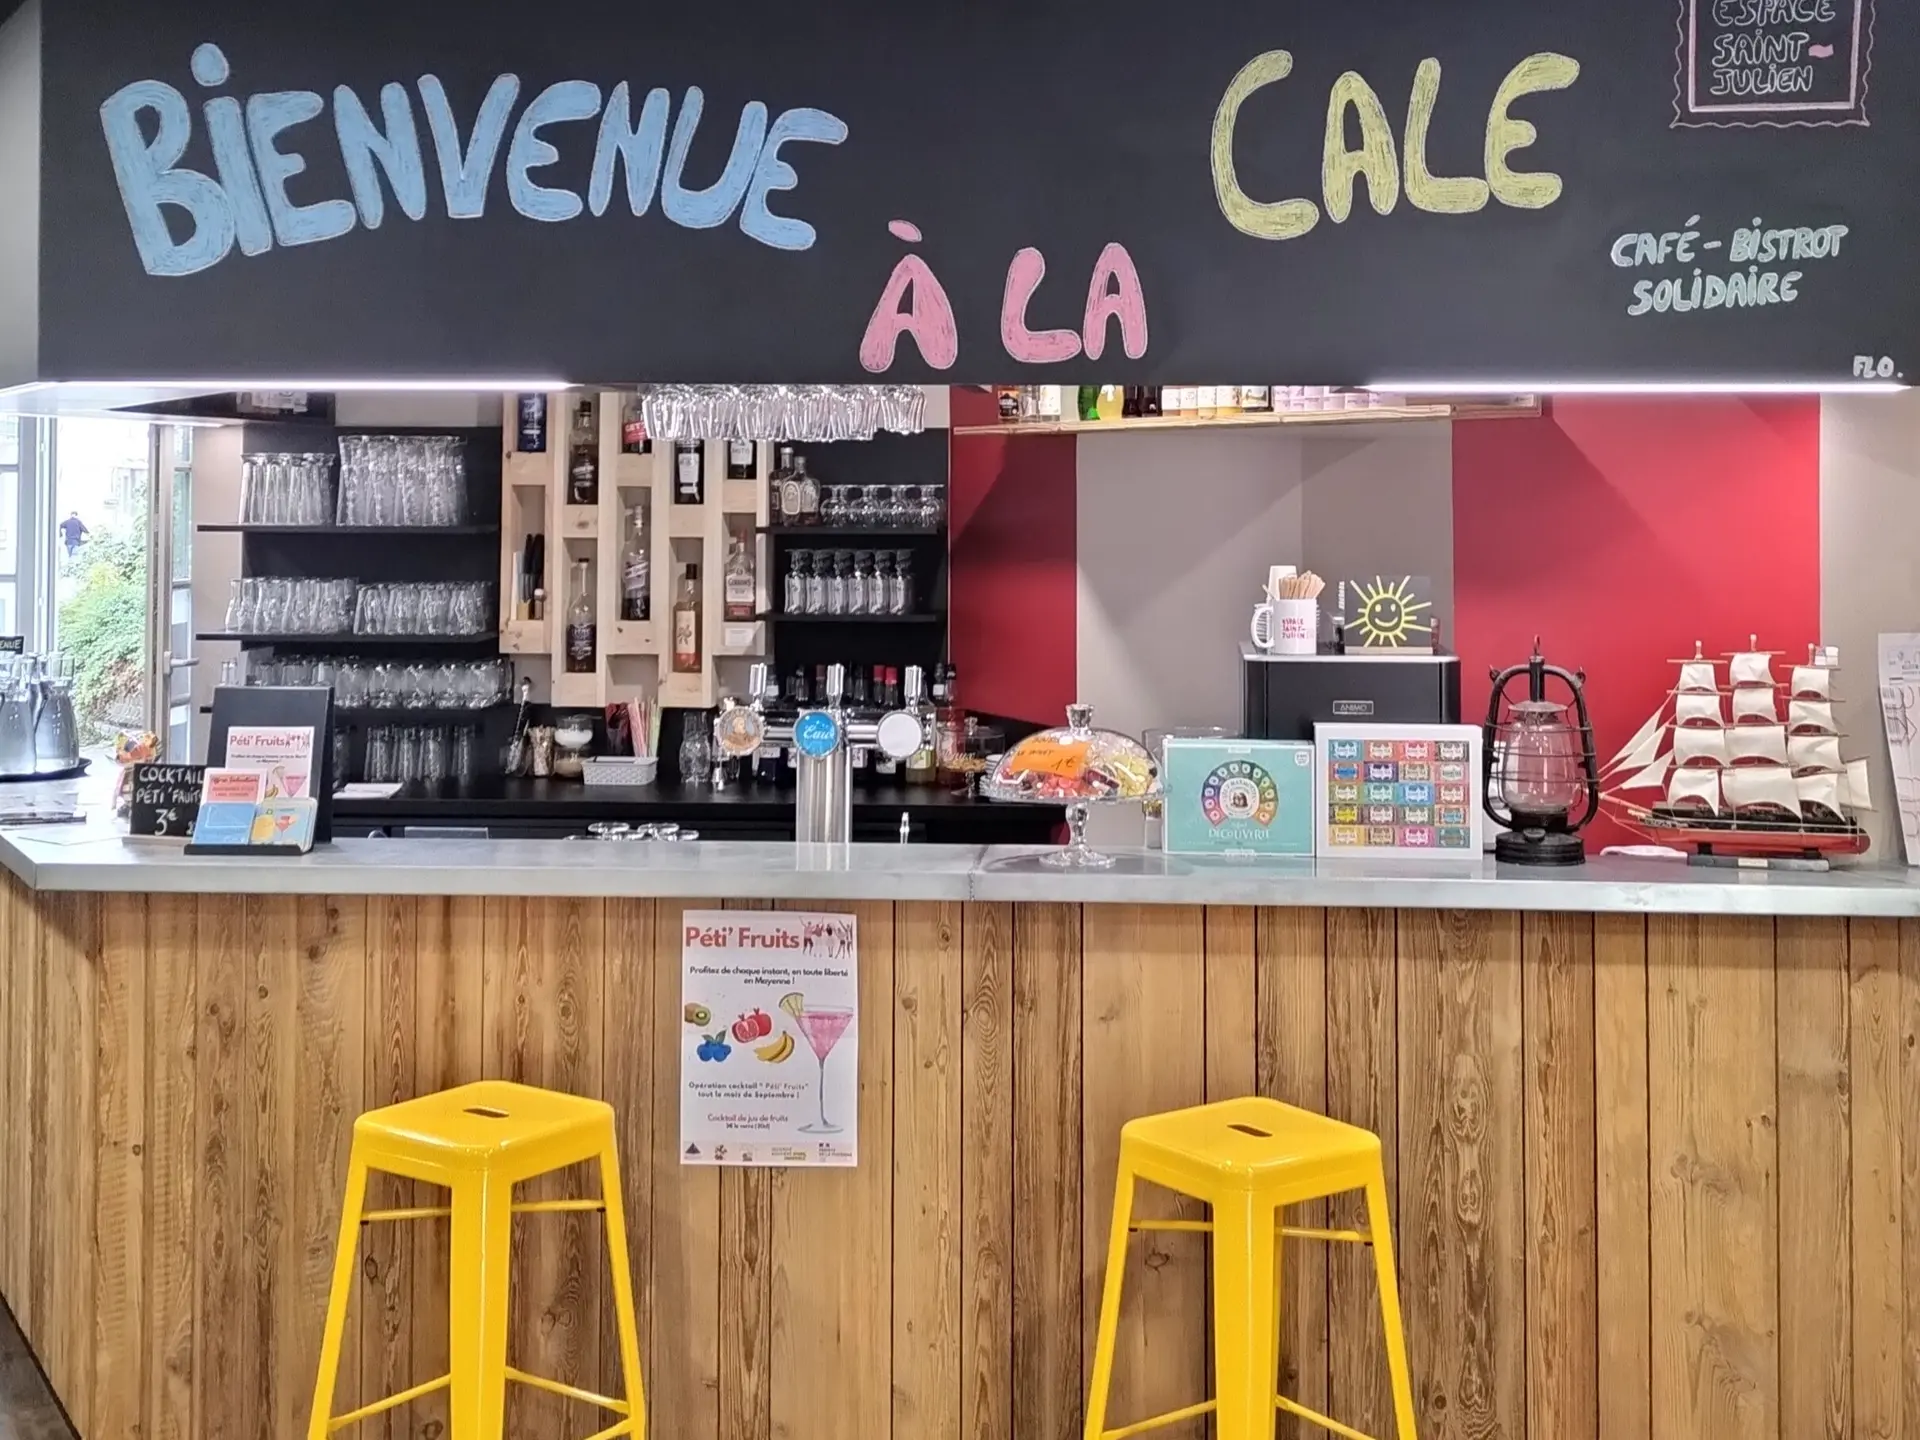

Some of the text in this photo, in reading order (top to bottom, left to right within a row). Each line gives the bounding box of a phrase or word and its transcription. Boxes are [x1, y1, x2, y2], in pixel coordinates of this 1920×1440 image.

[1712, 0, 1836, 27] ESPACE
[1709, 63, 1813, 95] JULIEN
[1211, 49, 1580, 240] CALE
[1610, 214, 1700, 267] CAFÉ
[859, 219, 1148, 373] À LA
[1627, 265, 1803, 316] SOLIDAIRE
[255, 735, 284, 746] Fruits
[138, 765, 204, 785] COCKTAIL
[685, 926, 800, 948] Péti' Fruits
[689, 966, 719, 975] Profitez
[720, 967, 731, 975] de
[732, 967, 761, 977] chaque
[761, 967, 790, 976] instant,
[803, 968, 823, 976] toute
[824, 968, 849, 977] liberté
[754, 977, 791, 987] Mayenne
[688, 1081, 727, 1091] Opération
[728, 1081, 758, 1090] cocktail
[714, 1090, 722, 1098] le
[754, 1091, 795, 1100] Septembre
[707, 1113, 789, 1123] Cocktail de jus de fruits
